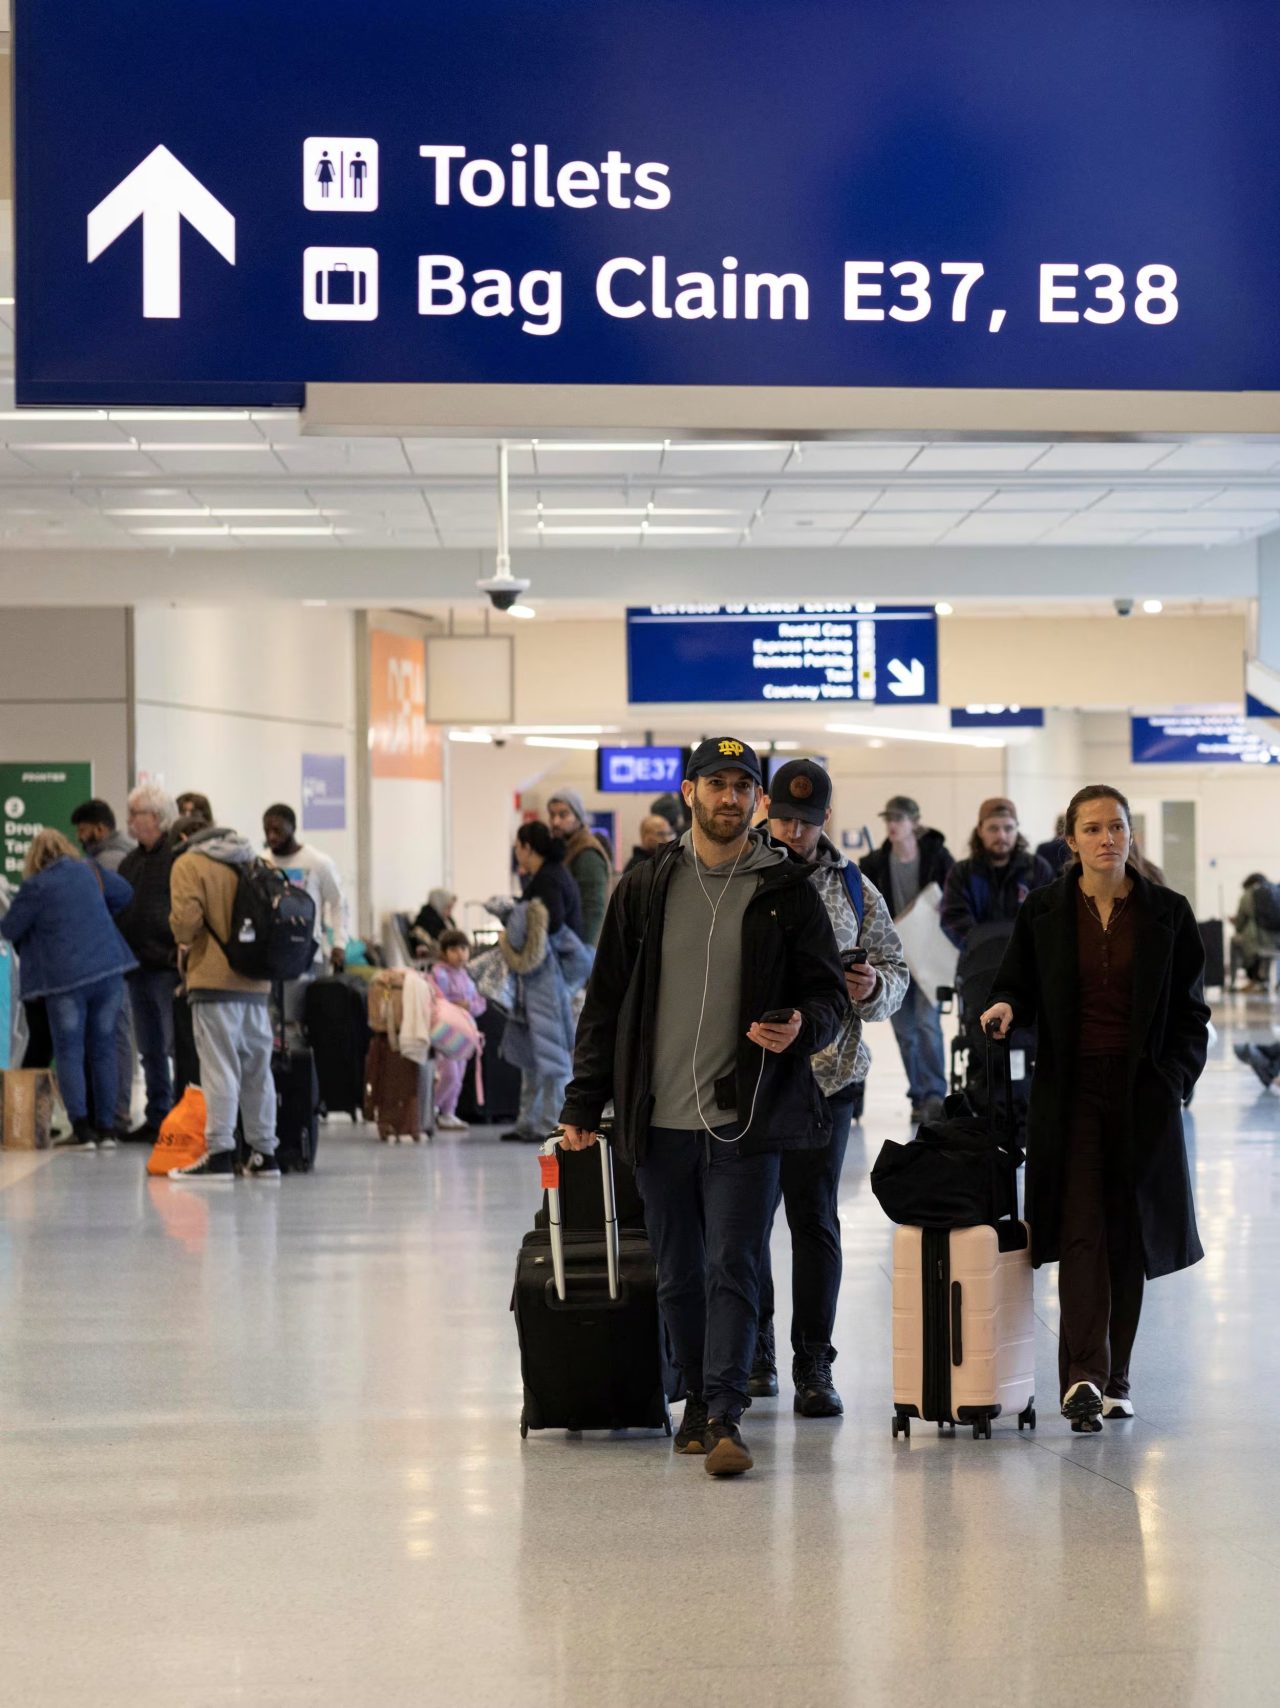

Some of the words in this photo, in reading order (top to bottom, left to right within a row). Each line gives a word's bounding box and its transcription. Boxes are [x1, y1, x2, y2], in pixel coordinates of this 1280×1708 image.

[419, 143, 672, 210] Toilets
[417, 254, 563, 336] Bag
[595, 255, 810, 321] Claim
[843, 260, 1007, 333] E37,
[1039, 262, 1179, 326] E38
[636, 757, 679, 781] E37
